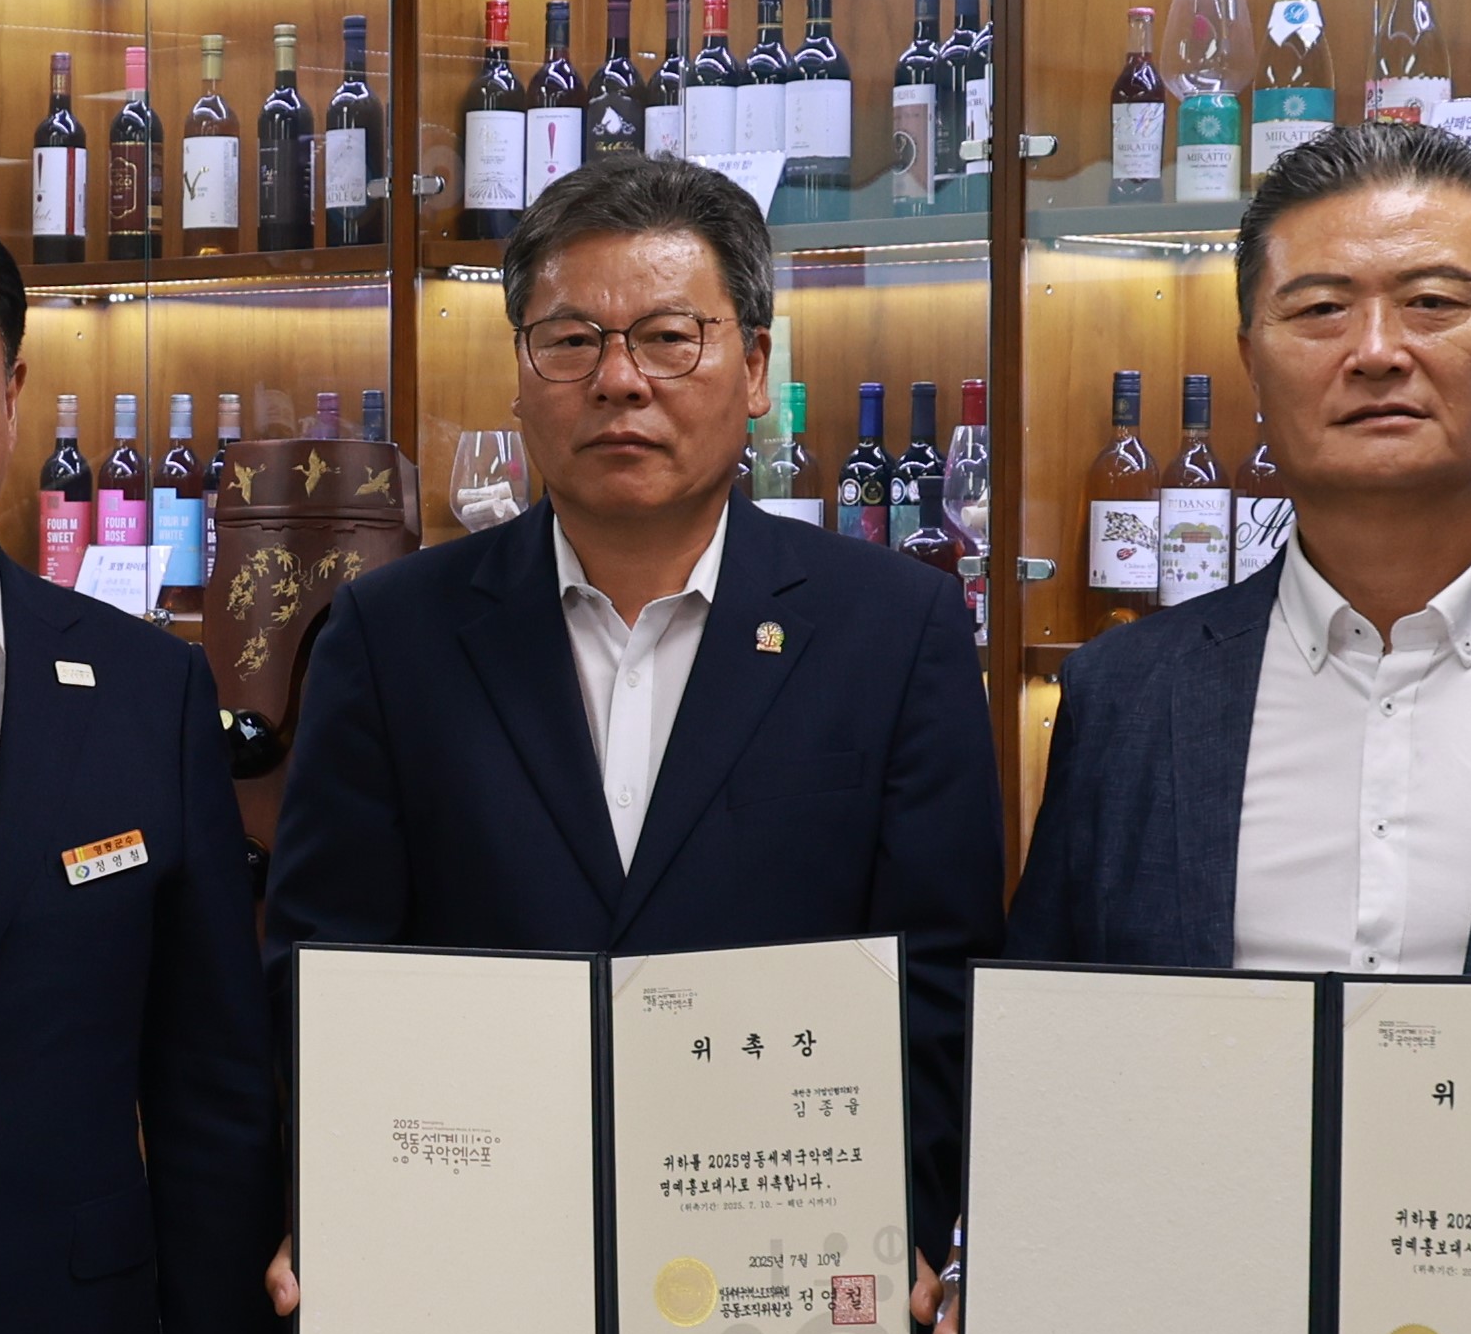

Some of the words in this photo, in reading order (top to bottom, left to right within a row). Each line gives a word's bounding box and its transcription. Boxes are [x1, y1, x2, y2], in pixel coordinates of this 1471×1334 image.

[1118, 142, 1159, 153] MIRATTO
[1187, 153, 1232, 163] MIRATTO
[46, 518, 69, 530] FOUR
[70, 518, 78, 529] M
[105, 517, 127, 528] FOUR
[128, 517, 136, 528] M
[46, 531, 75, 544] SWEET
[104, 530, 126, 542] ROSE
[112, 854, 122, 867] 영
[691, 1036, 711, 1063] 위
[741, 1033, 765, 1060] 촉
[792, 1029, 817, 1057] 장
[1432, 1080, 1455, 1110] 위
[793, 1100, 806, 1118] 김
[393, 1119, 420, 1129] 2025
[663, 1154, 702, 1172] 귀하를
[708, 1147, 863, 1169] 2025영동세계국악엑스포
[660, 1177, 750, 1197] 명예홍보대사로
[756, 1173, 831, 1193] 위촉합니다.
[1395, 1209, 1439, 1231] 귀하를
